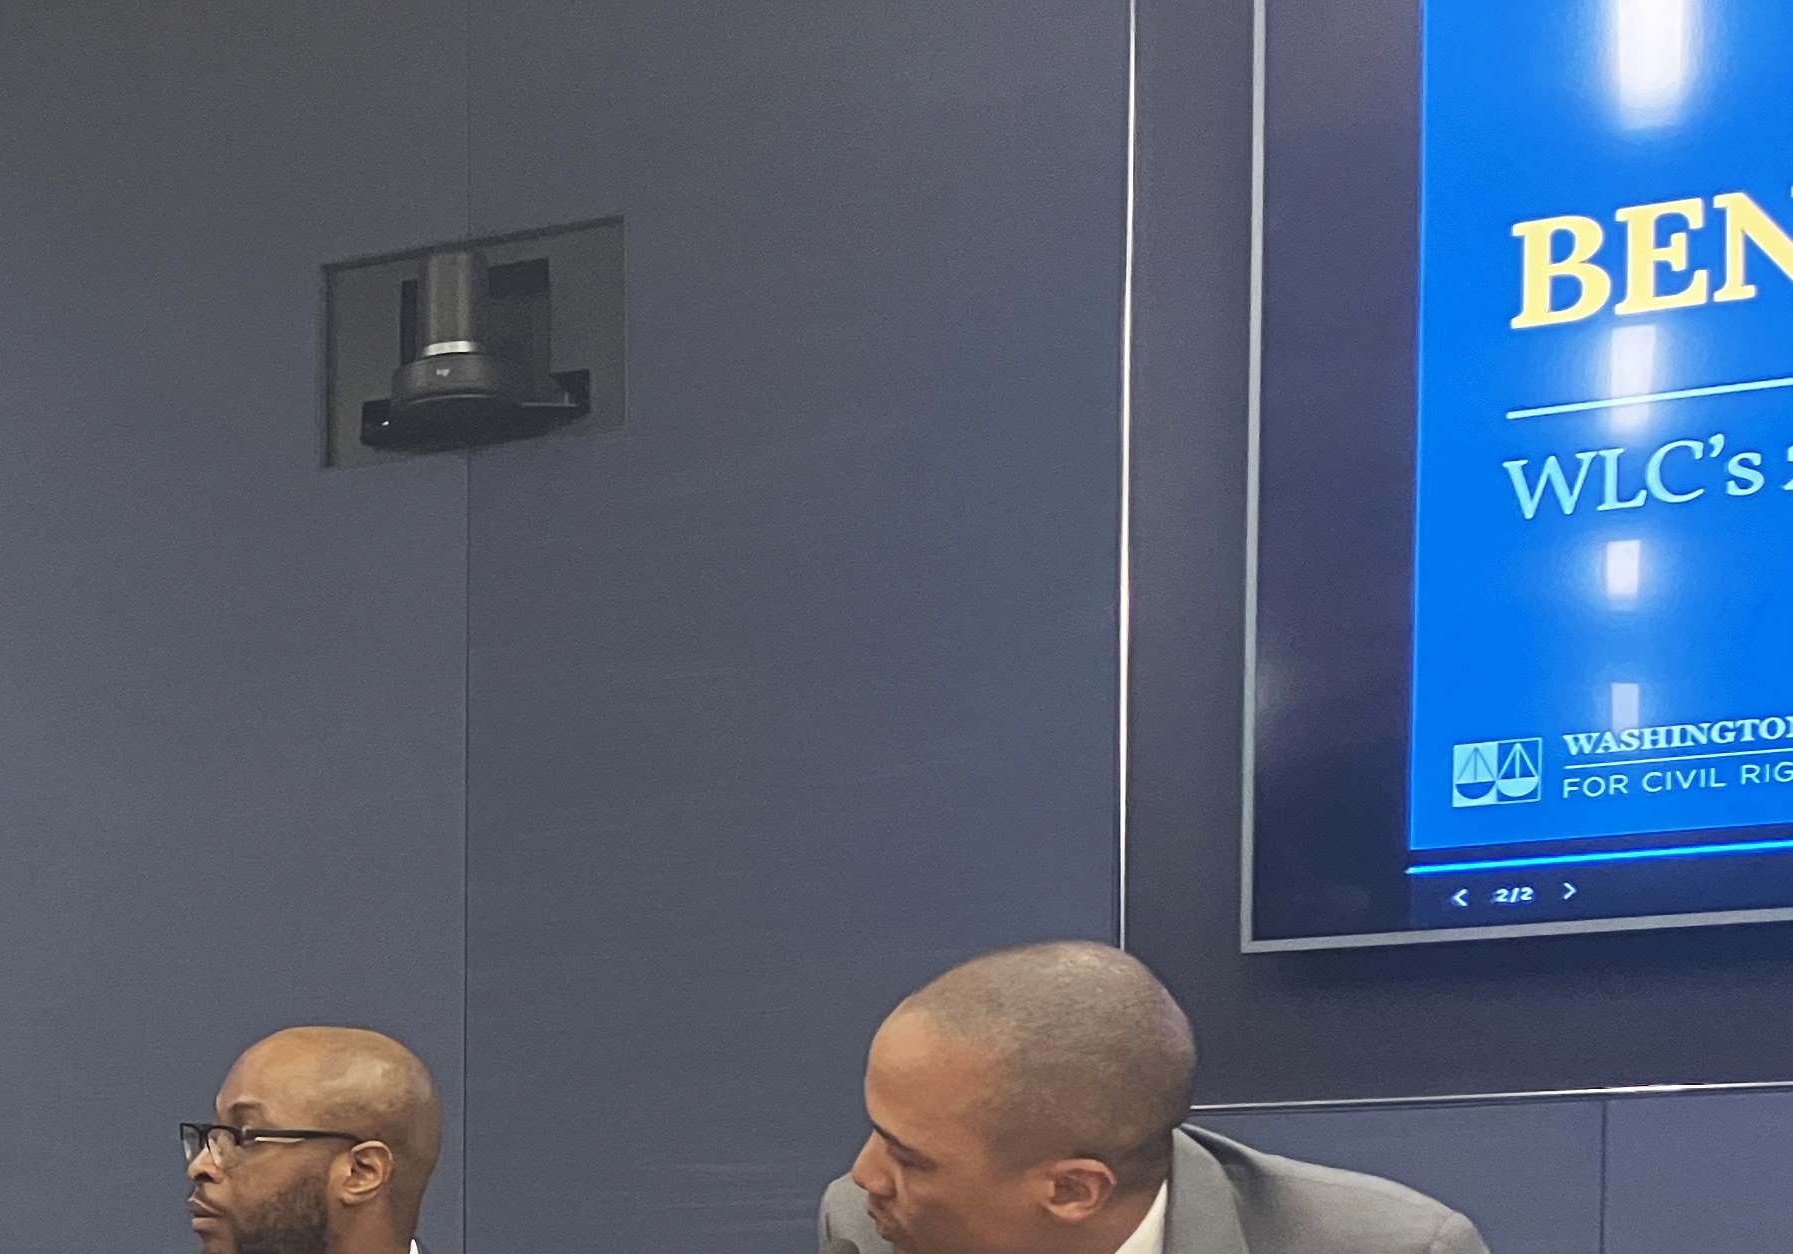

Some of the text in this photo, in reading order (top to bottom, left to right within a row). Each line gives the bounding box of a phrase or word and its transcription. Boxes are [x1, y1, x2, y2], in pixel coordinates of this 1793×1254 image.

[1502, 433, 1766, 520] WLC's
[1562, 775, 1628, 798] FOR
[1642, 767, 1726, 793] CIVIL
[1493, 886, 1535, 904] 2/2
